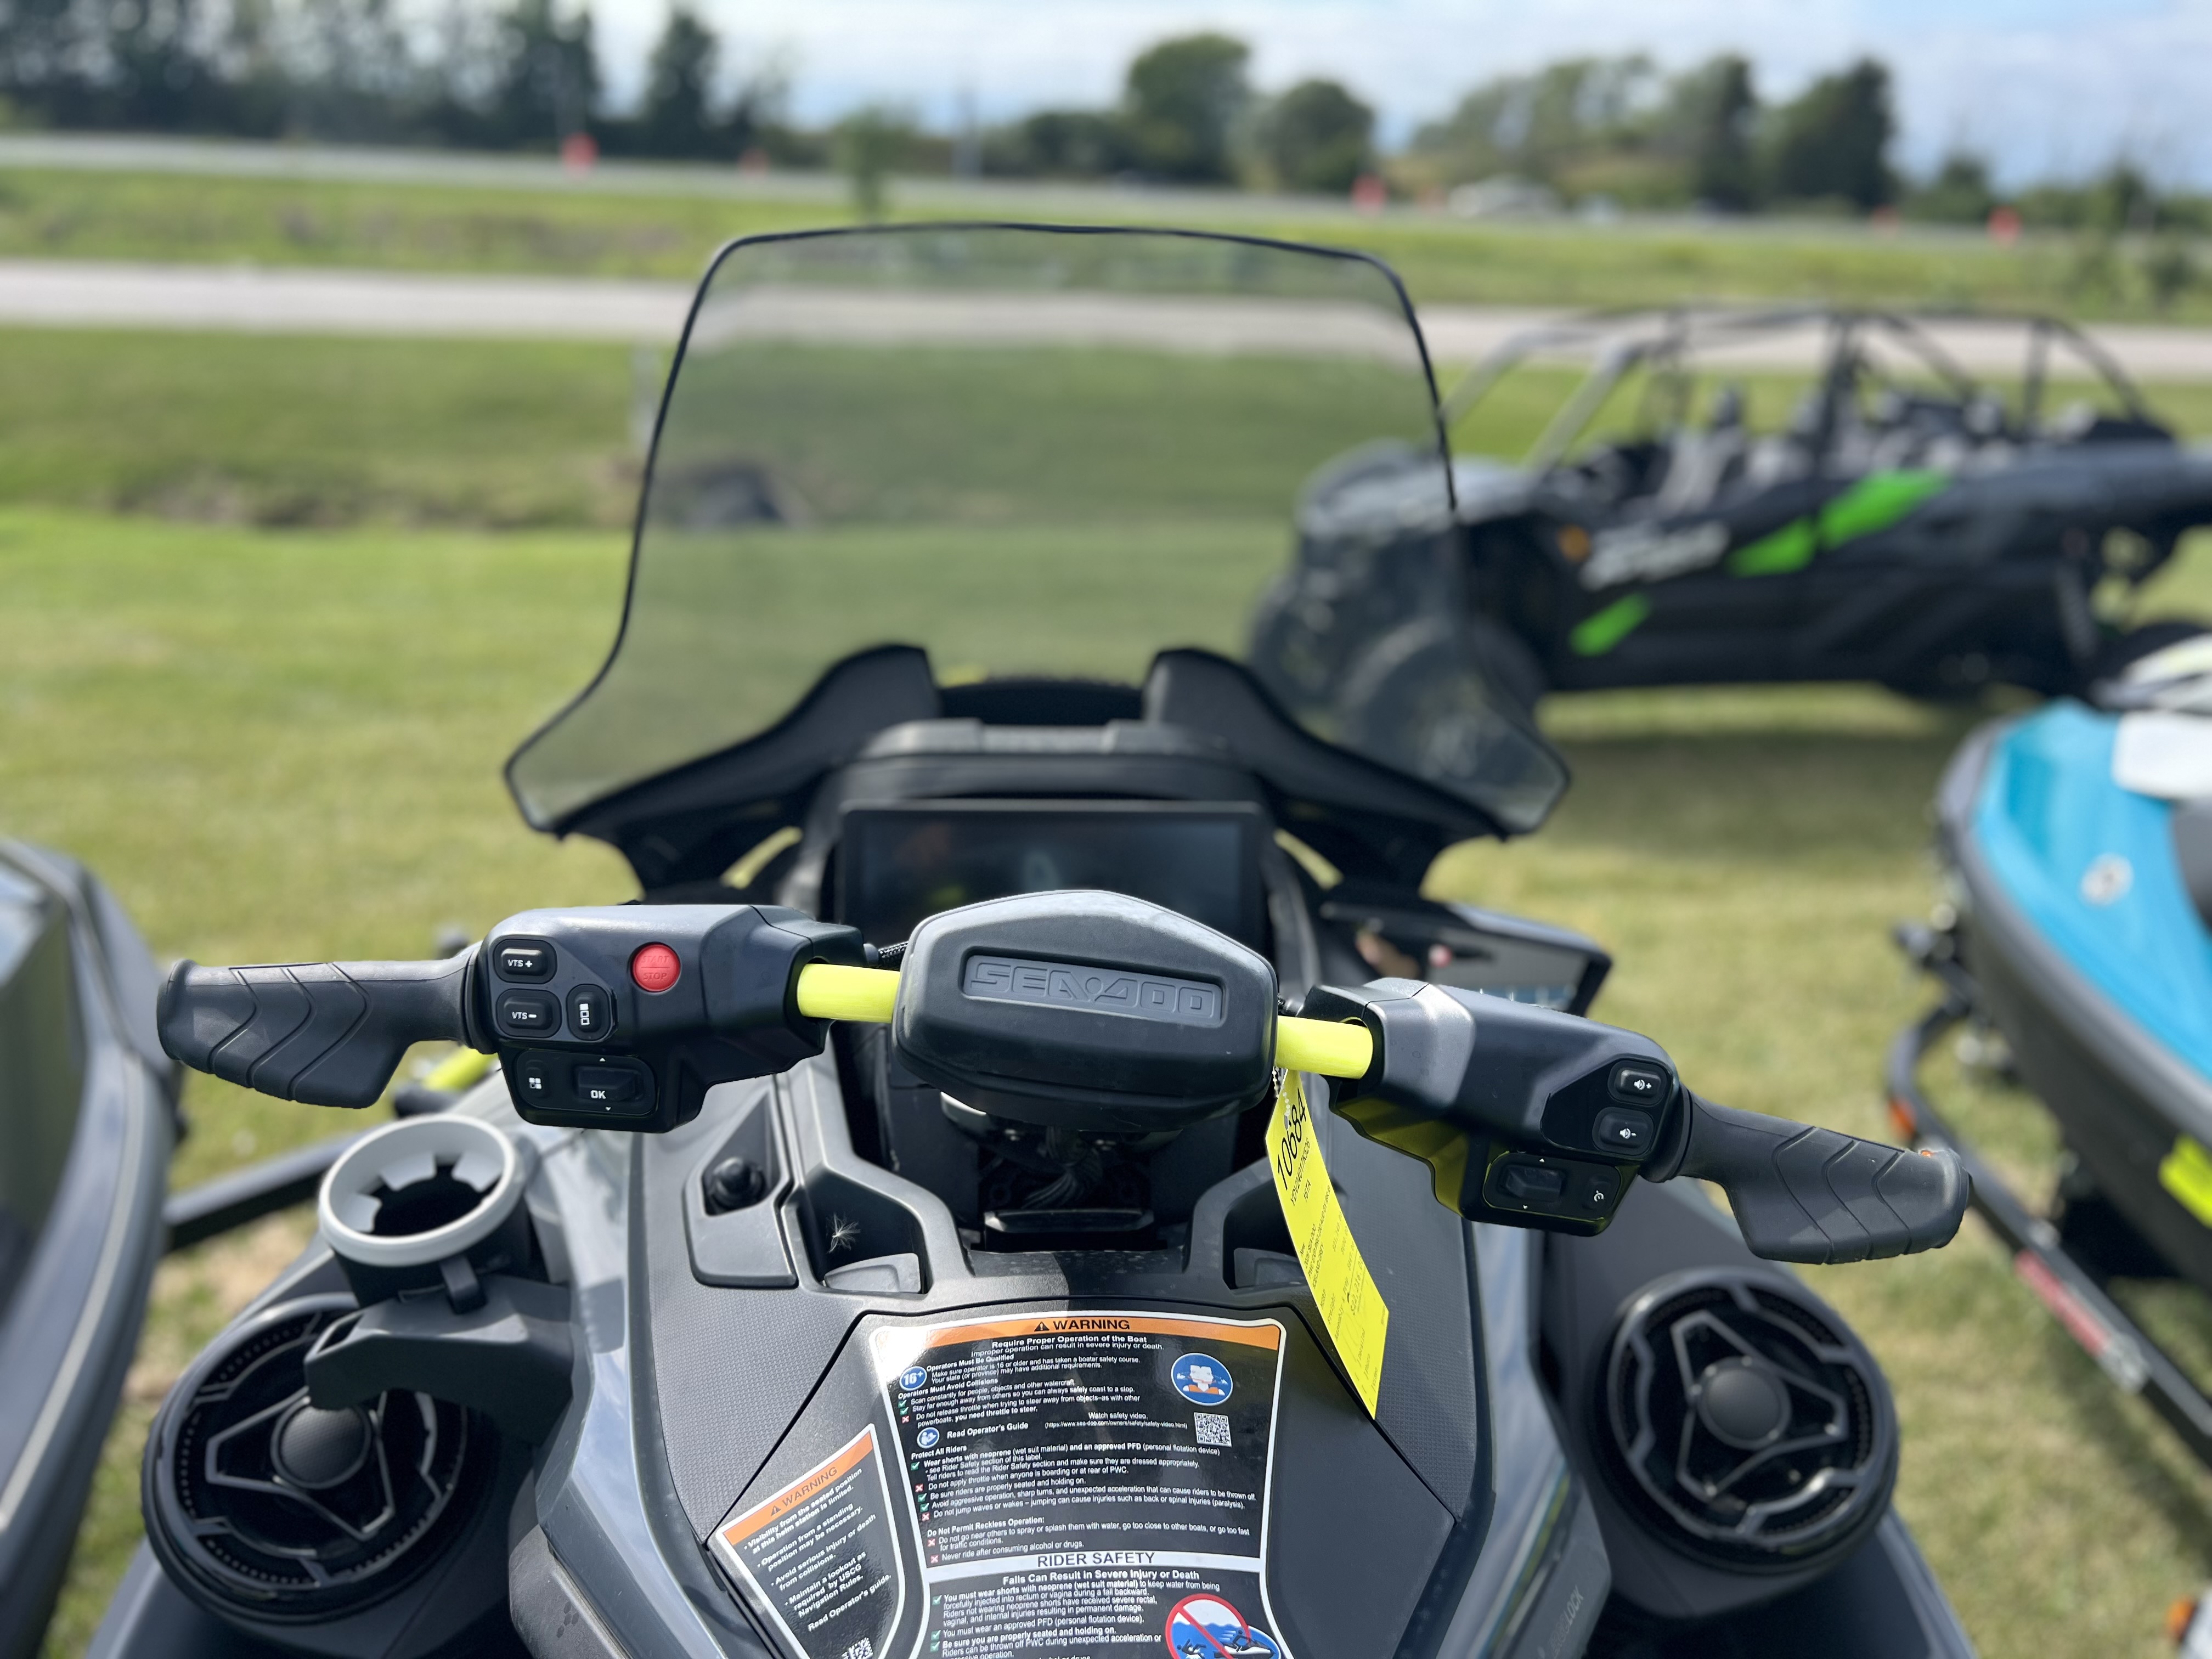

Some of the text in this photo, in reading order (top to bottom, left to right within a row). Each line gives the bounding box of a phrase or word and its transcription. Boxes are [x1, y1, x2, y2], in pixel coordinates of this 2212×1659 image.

[641, 955, 670, 963] START
[590, 1090, 606, 1099] OK
[1277, 1087, 1307, 1191] 10684
[1350, 1256, 1363, 1315] $22,216.00
[1053, 1319, 1130, 1330] WARNING
[1335, 1304, 1344, 1342] Assembly
[971, 1348, 1003, 1357] Improper
[1004, 1345, 1038, 1354] operation
[1112, 1342, 1131, 1350] injury
[992, 1339, 1024, 1348] Require
[1057, 1335, 1099, 1344] Operation
[926, 1362, 957, 1372] Operators
[958, 1357, 974, 1366] Must
[985, 1353, 1014, 1362] Qualified
[898, 1378, 998, 1400] Operators Must Avoid Collisions
[1109, 1412, 1128, 1421] safety
[947, 1429, 965, 1438] Read
[967, 1424, 1005, 1436] Operator's
[911, 1449, 934, 1459] Protect
[924, 1459, 941, 1467] Wear
[942, 1454, 962, 1463] shorts
[964, 1452, 978, 1460] with
[980, 1449, 1011, 1458] neoprene
[1013, 1447, 1026, 1456] (wet
[1040, 1444, 1068, 1452] material)
[1143, 1443, 1171, 1451] (personal
[1173, 1445, 1197, 1453] flotation
[1198, 1447, 1220, 1456] device)
[782, 1466, 837, 1506] WARNING
[748, 1469, 862, 1547] Visibility from the seated position
[753, 1545, 760, 1554] at
[761, 1536, 775, 1548] this
[776, 1524, 794, 1539] helm
[795, 1508, 820, 1527] station
[828, 1485, 854, 1505] limited.
[761, 1540, 797, 1565] Operation
[798, 1529, 815, 1542] from
[823, 1503, 853, 1527] standing
[951, 1523, 973, 1533] Permit
[975, 1521, 1006, 1529] Reckless
[1008, 1518, 1044, 1527] Operation:
[768, 1506, 863, 1572] position may be necessary.
[776, 1514, 876, 1584] Avoid serious injury or death
[992, 1544, 1028, 1554] consuming
[1030, 1541, 1053, 1549] alcohol
[1037, 1552, 1155, 1567] RIDER SAFETY
[779, 1554, 836, 1591] from collisions.
[789, 1581, 821, 1603] Maintain
[828, 1558, 856, 1579] lookout
[857, 1552, 866, 1562] as
[1003, 1575, 1025, 1585] Falls
[1028, 1573, 1047, 1582] Can
[1050, 1571, 1080, 1580] Result
[1083, 1571, 1092, 1579] in
[1130, 1570, 1157, 1580] Injury
[1172, 1570, 1199, 1579] Death
[794, 1564, 861, 1610] required by USCG
[798, 1575, 863, 1618] Navigation Rules.
[808, 1574, 891, 1631] Read Operator's guide.
[957, 1626, 973, 1635] must
[1004, 1619, 1035, 1630] approved
[1037, 1618, 1053, 1626] PFD
[1054, 1616, 1086, 1626] (personal
[1117, 1616, 1144, 1624] device).
